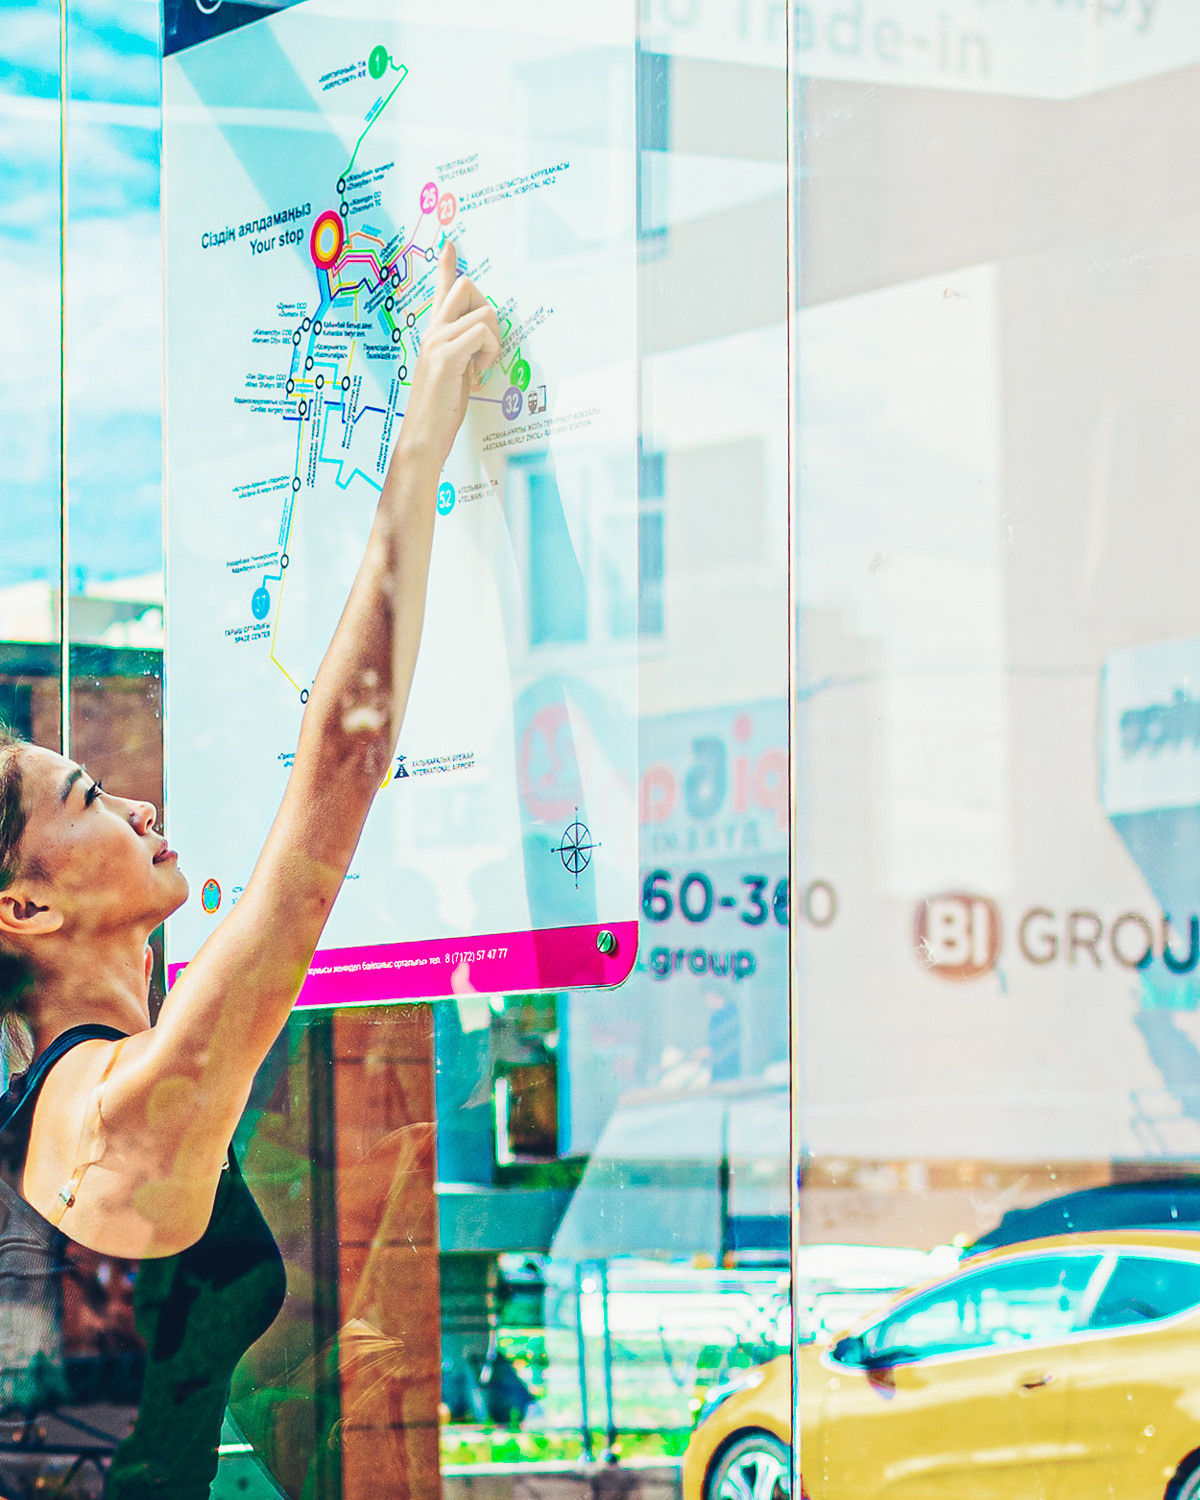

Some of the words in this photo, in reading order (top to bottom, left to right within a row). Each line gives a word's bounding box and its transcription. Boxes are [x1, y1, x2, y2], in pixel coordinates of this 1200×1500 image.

[422, 186, 437, 210] 25
[439, 197, 455, 221] 23
[200, 225, 236, 250] Сіздің
[237, 202, 313, 240] аялдамаңыз
[249, 237, 276, 257] Your
[278, 227, 305, 250] stop
[515, 367, 525, 387] 2
[505, 393, 520, 415] 32
[438, 488, 452, 509] 52
[926, 902, 990, 967] BI
[444, 953, 451, 964] 8
[451, 951, 476, 965] (7172)
[476, 949, 486, 960] 57
[486, 949, 497, 960] 47
[497, 948, 509, 959] 77
[650, 946, 757, 983] group
